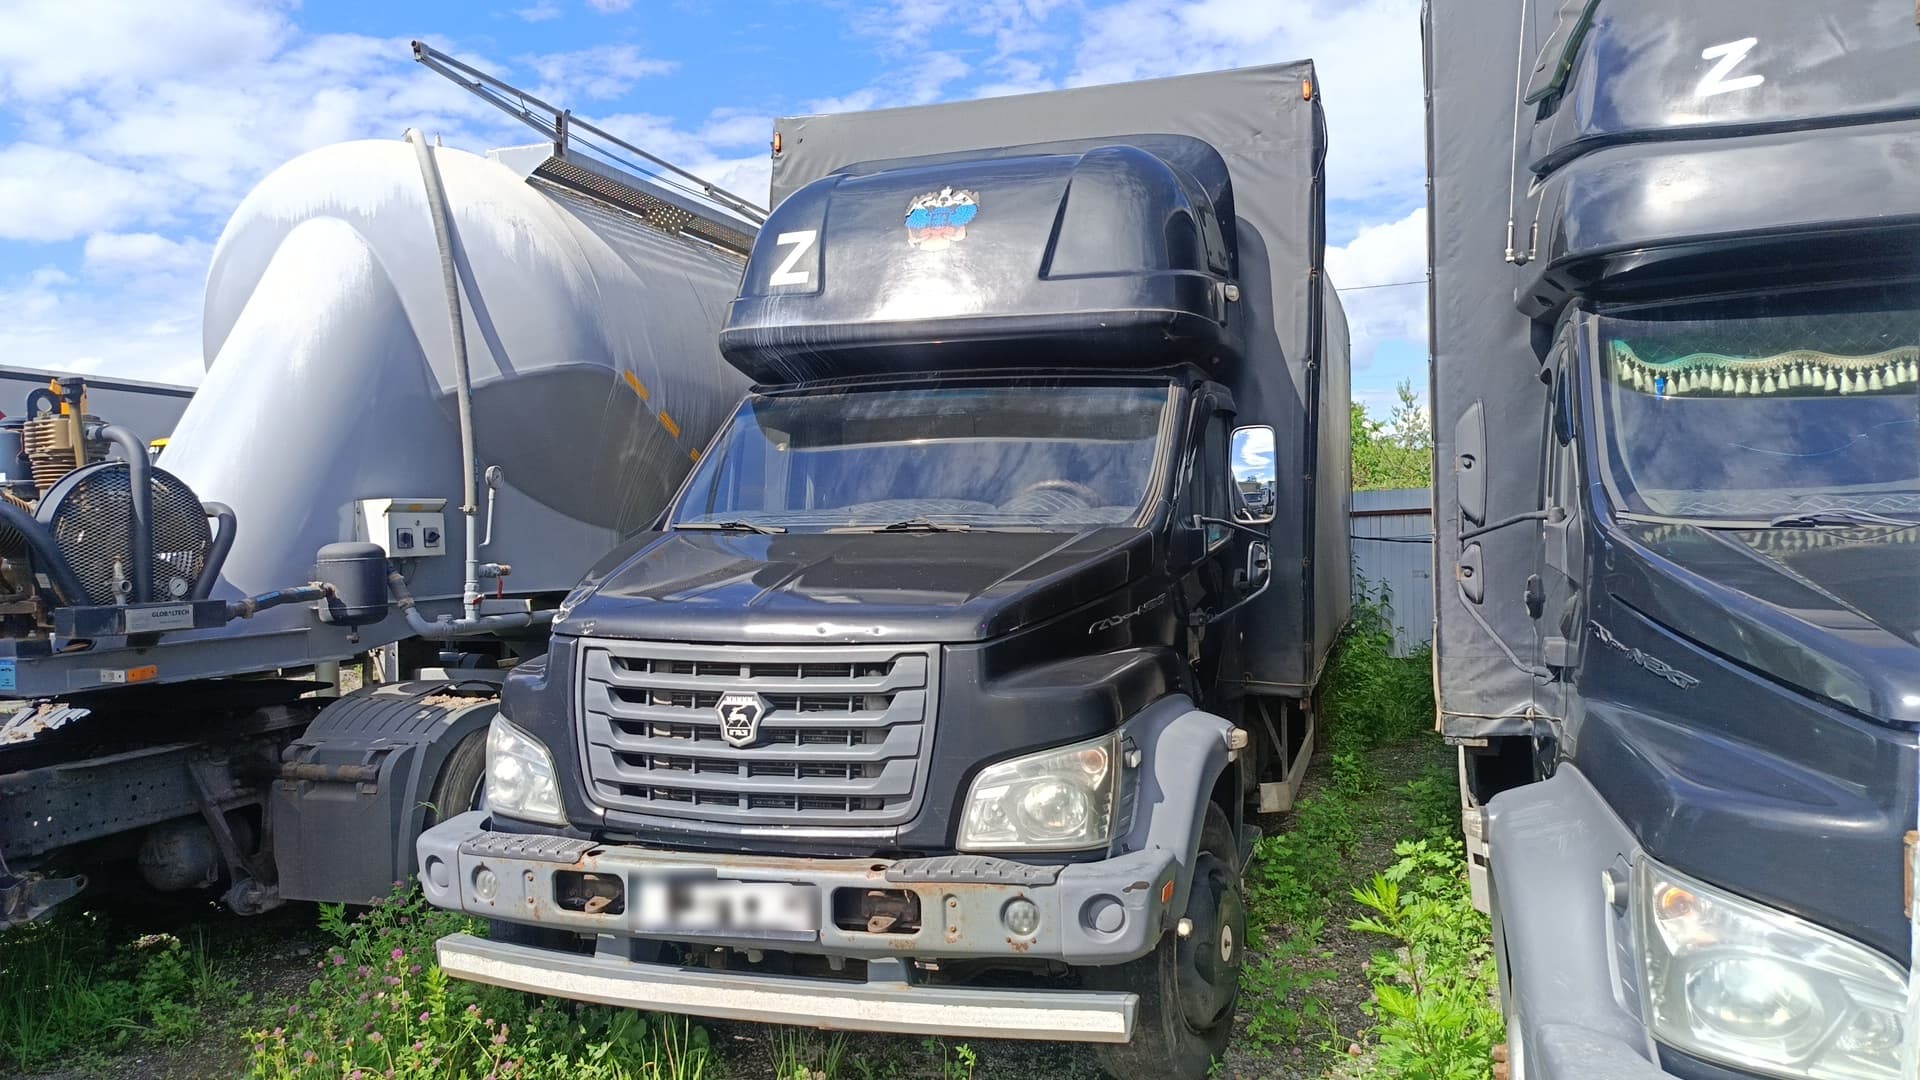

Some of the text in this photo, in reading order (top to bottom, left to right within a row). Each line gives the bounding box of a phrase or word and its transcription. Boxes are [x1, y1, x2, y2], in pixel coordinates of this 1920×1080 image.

[1694, 37, 1765, 97] Z
[769, 230, 817, 286] Z
[1630, 647, 1701, 690] NEXT
